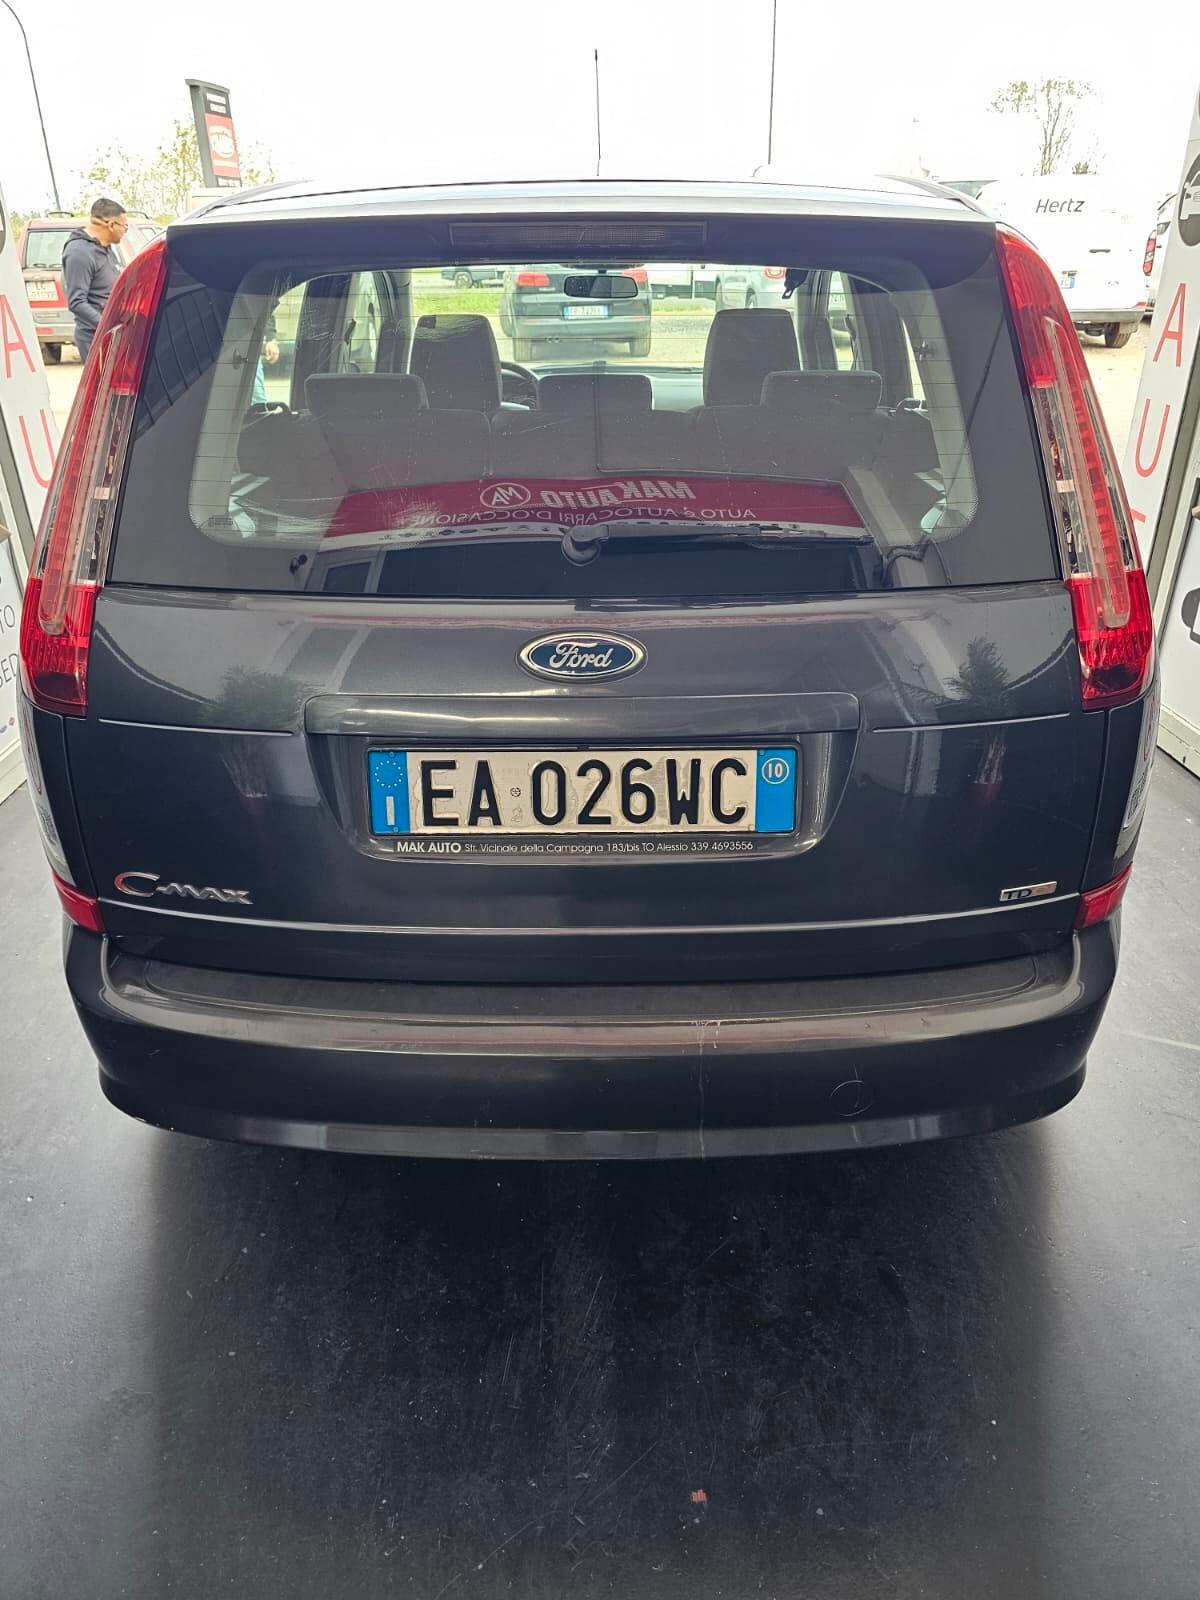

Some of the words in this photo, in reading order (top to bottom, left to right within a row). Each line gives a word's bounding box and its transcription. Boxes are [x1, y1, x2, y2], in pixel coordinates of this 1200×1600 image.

[1035, 198, 1085, 214] Hertz
[549, 641, 614, 668] Ford
[421, 759, 502, 827] EA
[397, 841, 424, 853] MAK
[428, 841, 461, 853] AUTO
[480, 843, 518, 853] Vicinale
[521, 842, 544, 853] della
[546, 843, 604, 855] Campagna
[606, 843, 640, 853] 183/bis
[642, 842, 655, 852] TO
[657, 842, 688, 852] Alessio
[690, 842, 708, 851] 339
[711, 841, 753, 851] 4693556
